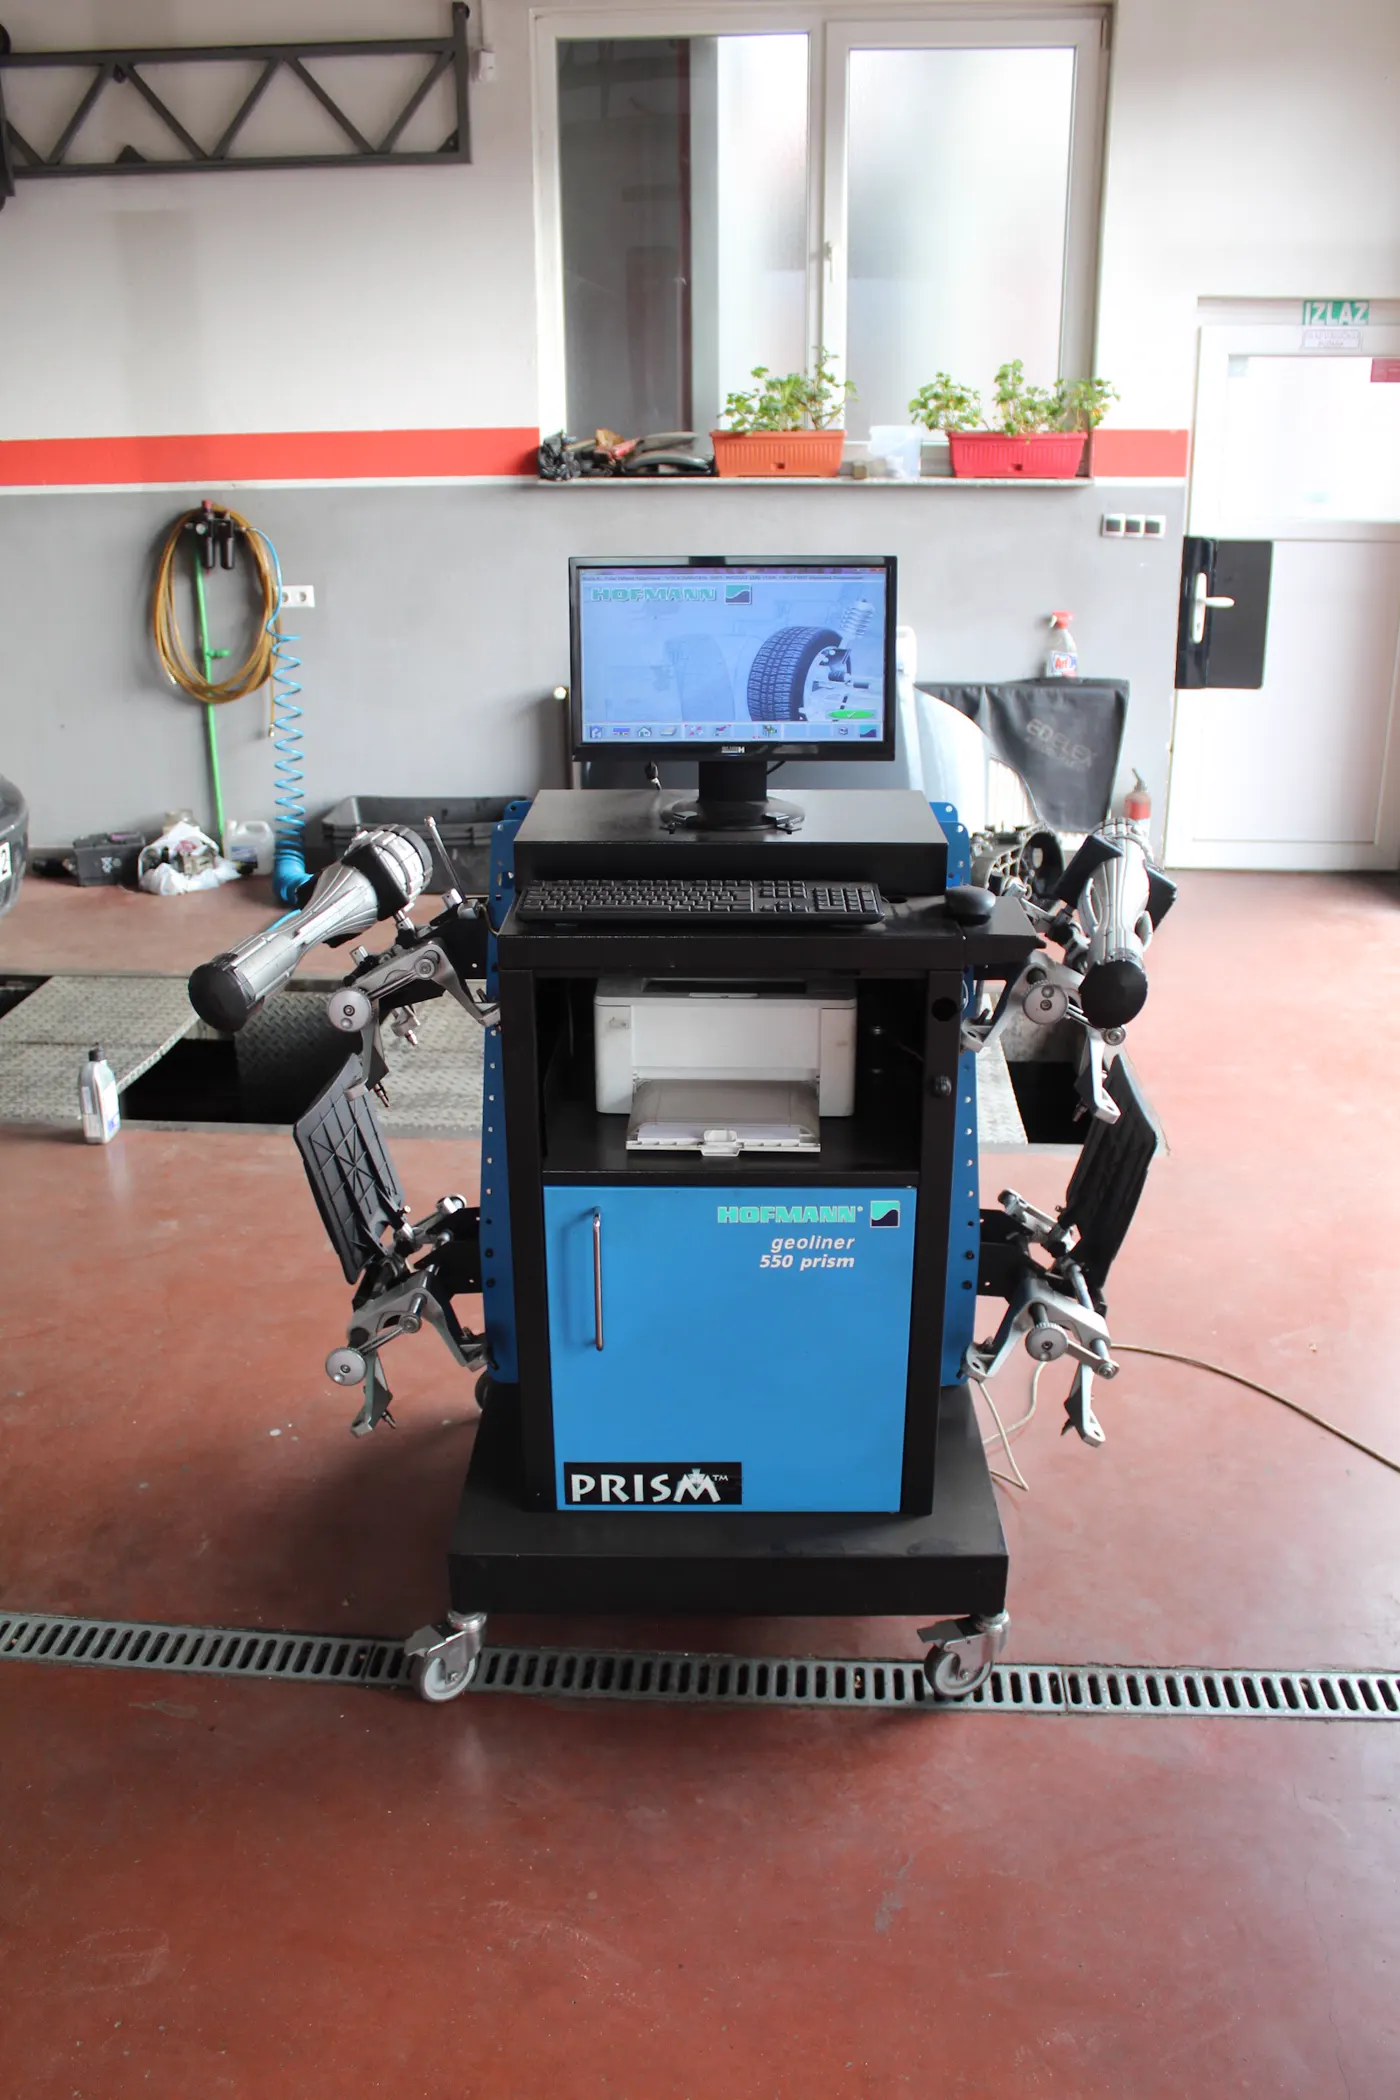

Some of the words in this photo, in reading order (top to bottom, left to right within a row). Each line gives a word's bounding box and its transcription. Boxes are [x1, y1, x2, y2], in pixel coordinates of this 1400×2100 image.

[1304, 301, 1368, 325] IZLAZ
[592, 588, 716, 601] HOFMANN
[717, 1206, 857, 1223] HOFMANN
[771, 1235, 856, 1253] geoliner
[759, 1254, 794, 1268] 550
[799, 1254, 855, 1271] prism
